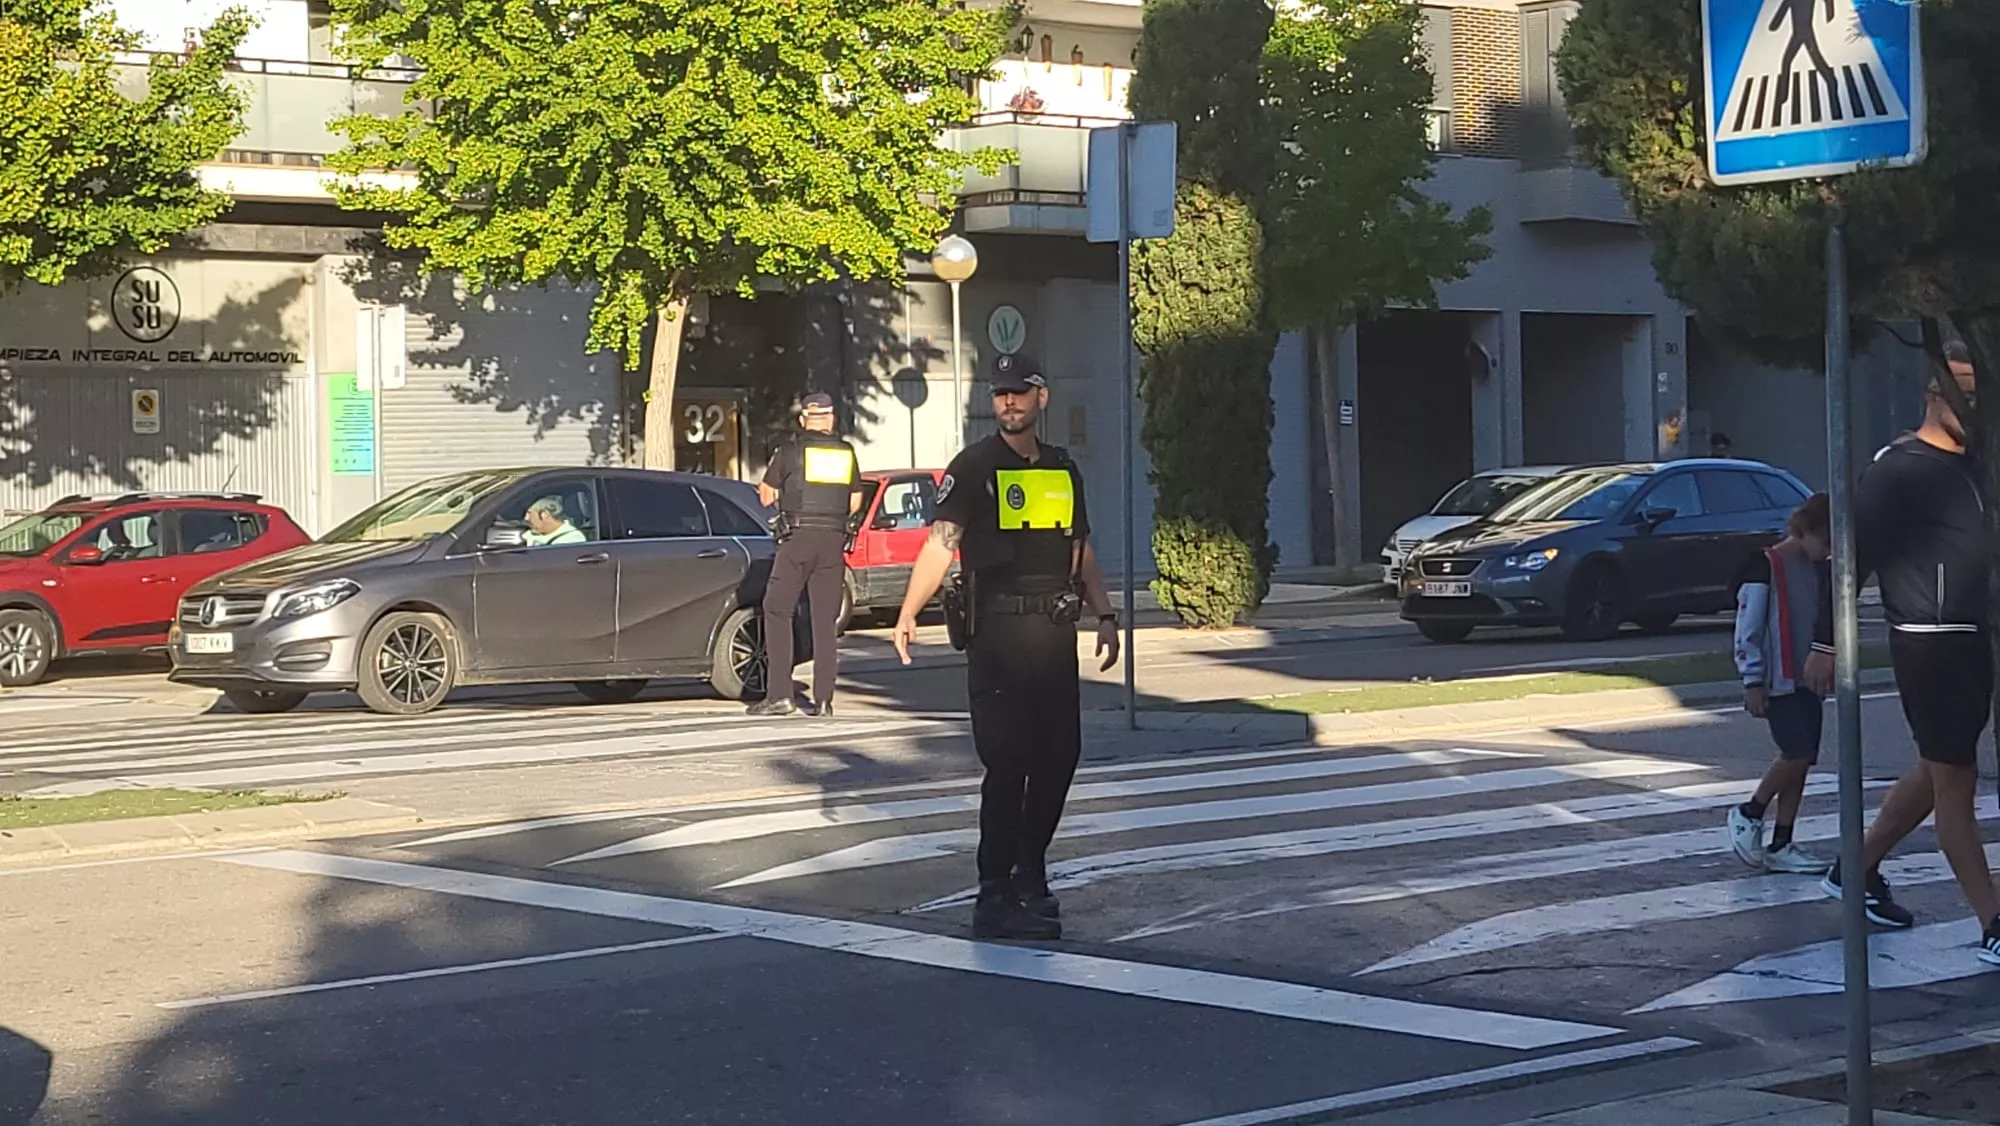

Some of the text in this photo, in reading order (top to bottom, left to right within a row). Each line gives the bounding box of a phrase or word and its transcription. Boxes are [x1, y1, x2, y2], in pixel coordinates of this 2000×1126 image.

[131, 279, 161, 303] SU
[132, 305, 161, 330] SU
[72, 349, 160, 362] INTEGRAL
[167, 351, 201, 363] DEL
[208, 351, 304, 364] AUTOMOVIL
[684, 404, 727, 443] 32
